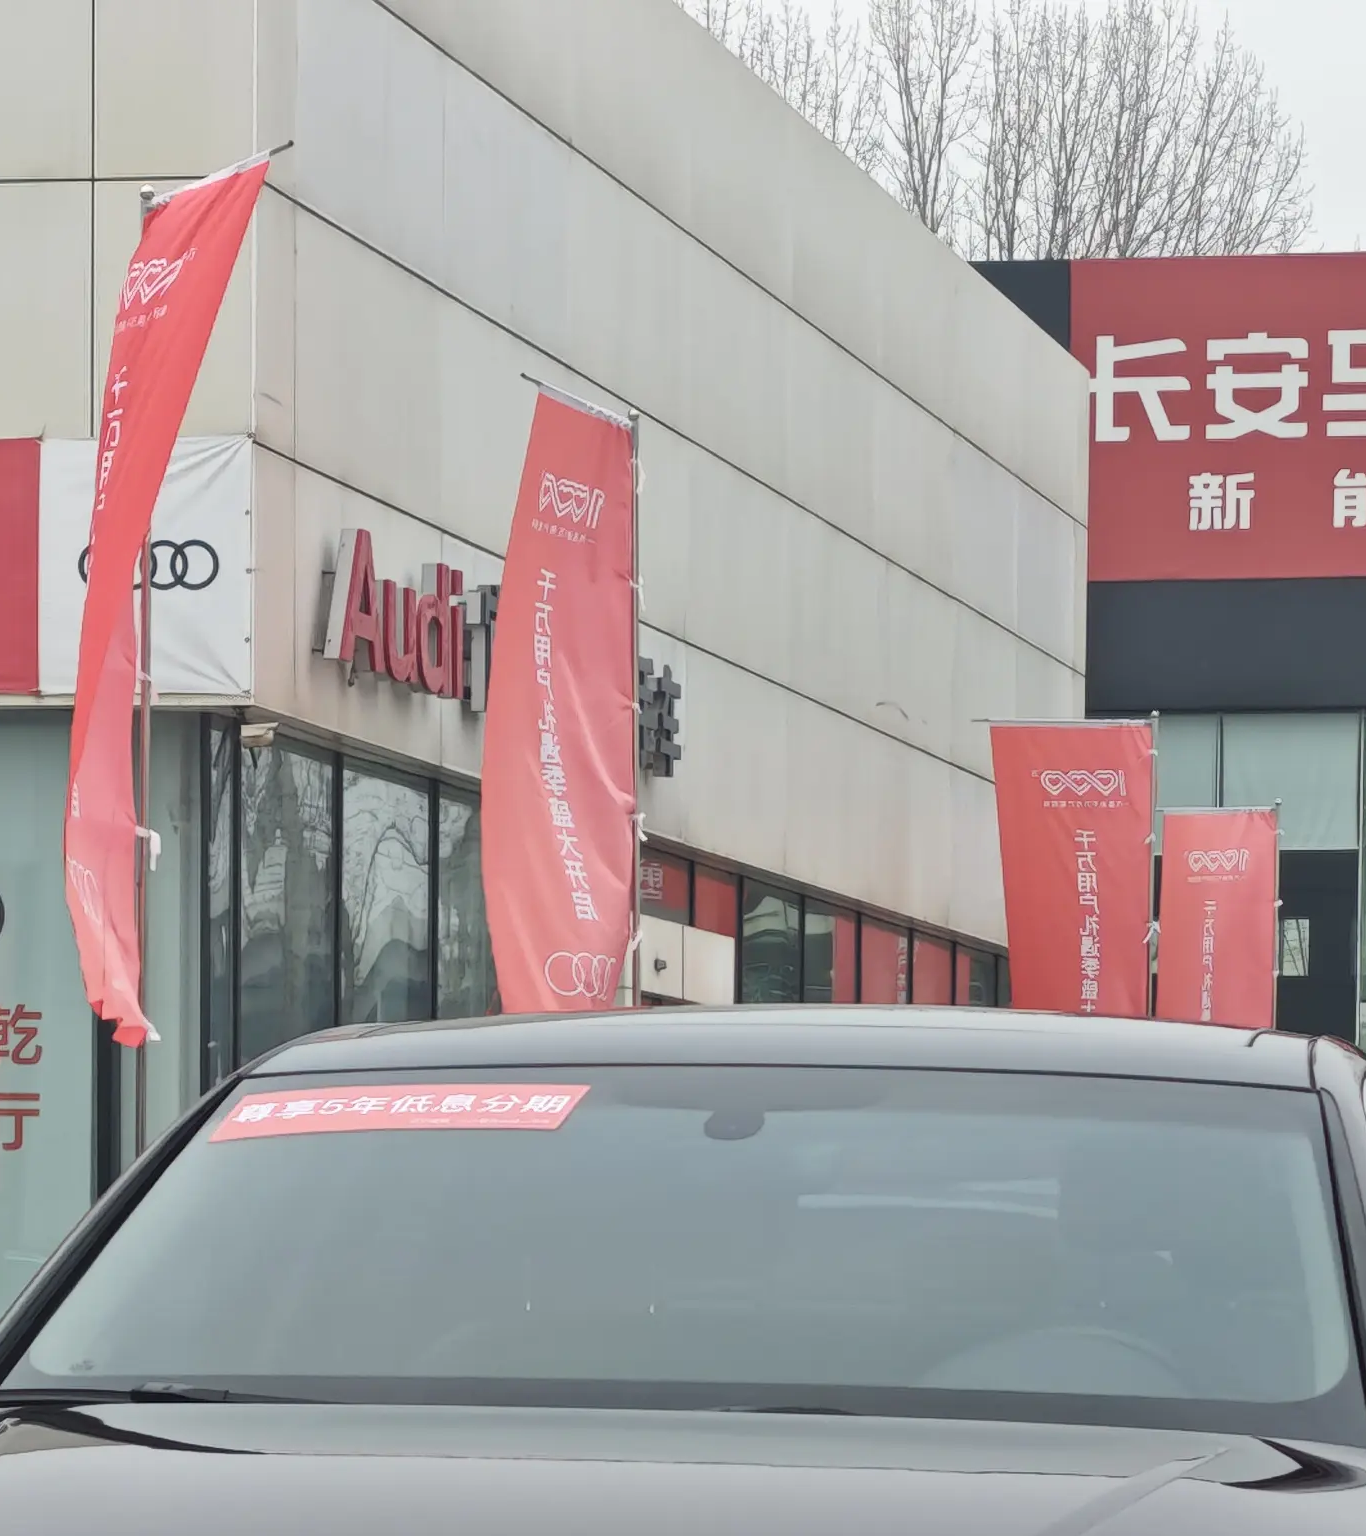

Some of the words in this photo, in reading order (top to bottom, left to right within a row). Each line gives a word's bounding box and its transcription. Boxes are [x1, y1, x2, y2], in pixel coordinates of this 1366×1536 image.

[325, 528, 463, 700] Audi
[231, 1093, 573, 1124] 尊享5年低息分期
